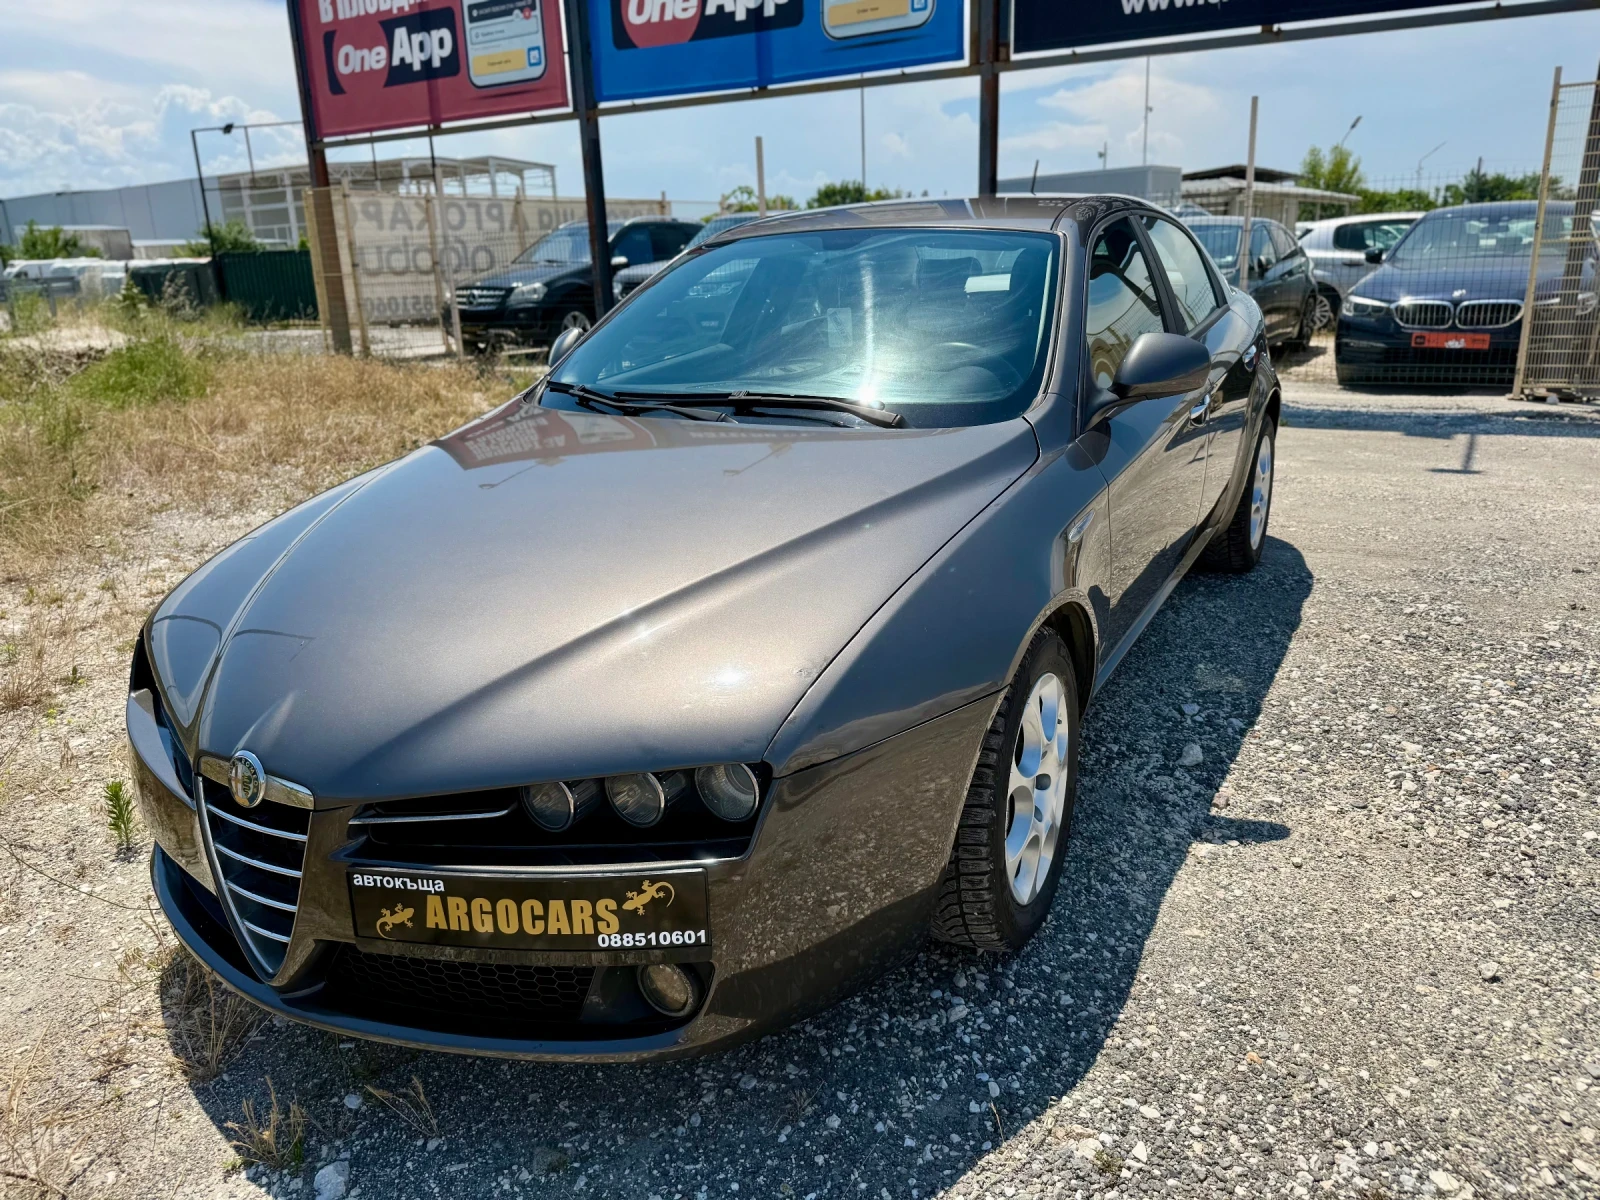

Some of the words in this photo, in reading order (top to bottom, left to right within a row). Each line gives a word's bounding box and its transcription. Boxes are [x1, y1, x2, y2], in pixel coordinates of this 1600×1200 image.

[626, 0, 698, 26] One
[338, 44, 387, 75] One
[391, 26, 453, 72] App
[353, 873, 445, 893] автокъща
[425, 894, 621, 935] ARGOCARS
[597, 929, 707, 948] 088510601
